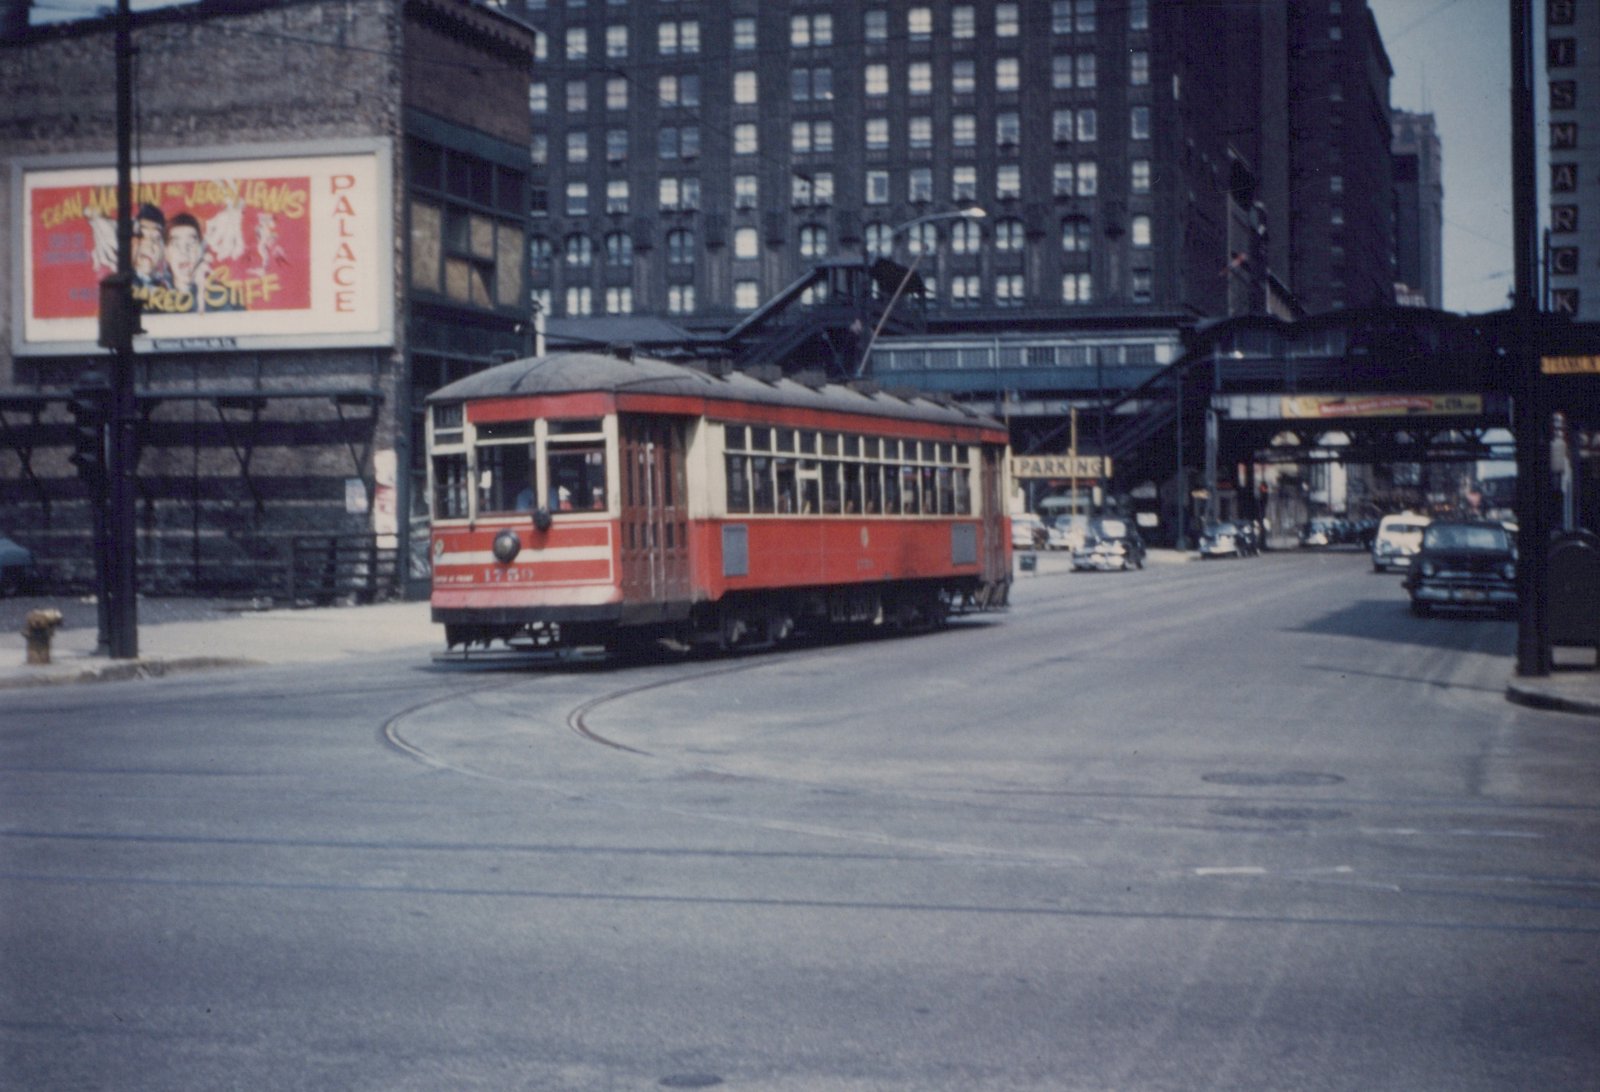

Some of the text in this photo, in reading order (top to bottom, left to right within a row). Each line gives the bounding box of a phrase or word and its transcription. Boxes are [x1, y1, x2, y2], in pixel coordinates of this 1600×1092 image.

[88, 183, 161, 216] MATIN
[329, 174, 356, 313] PALACE
[205, 265, 282, 308] STIFF
